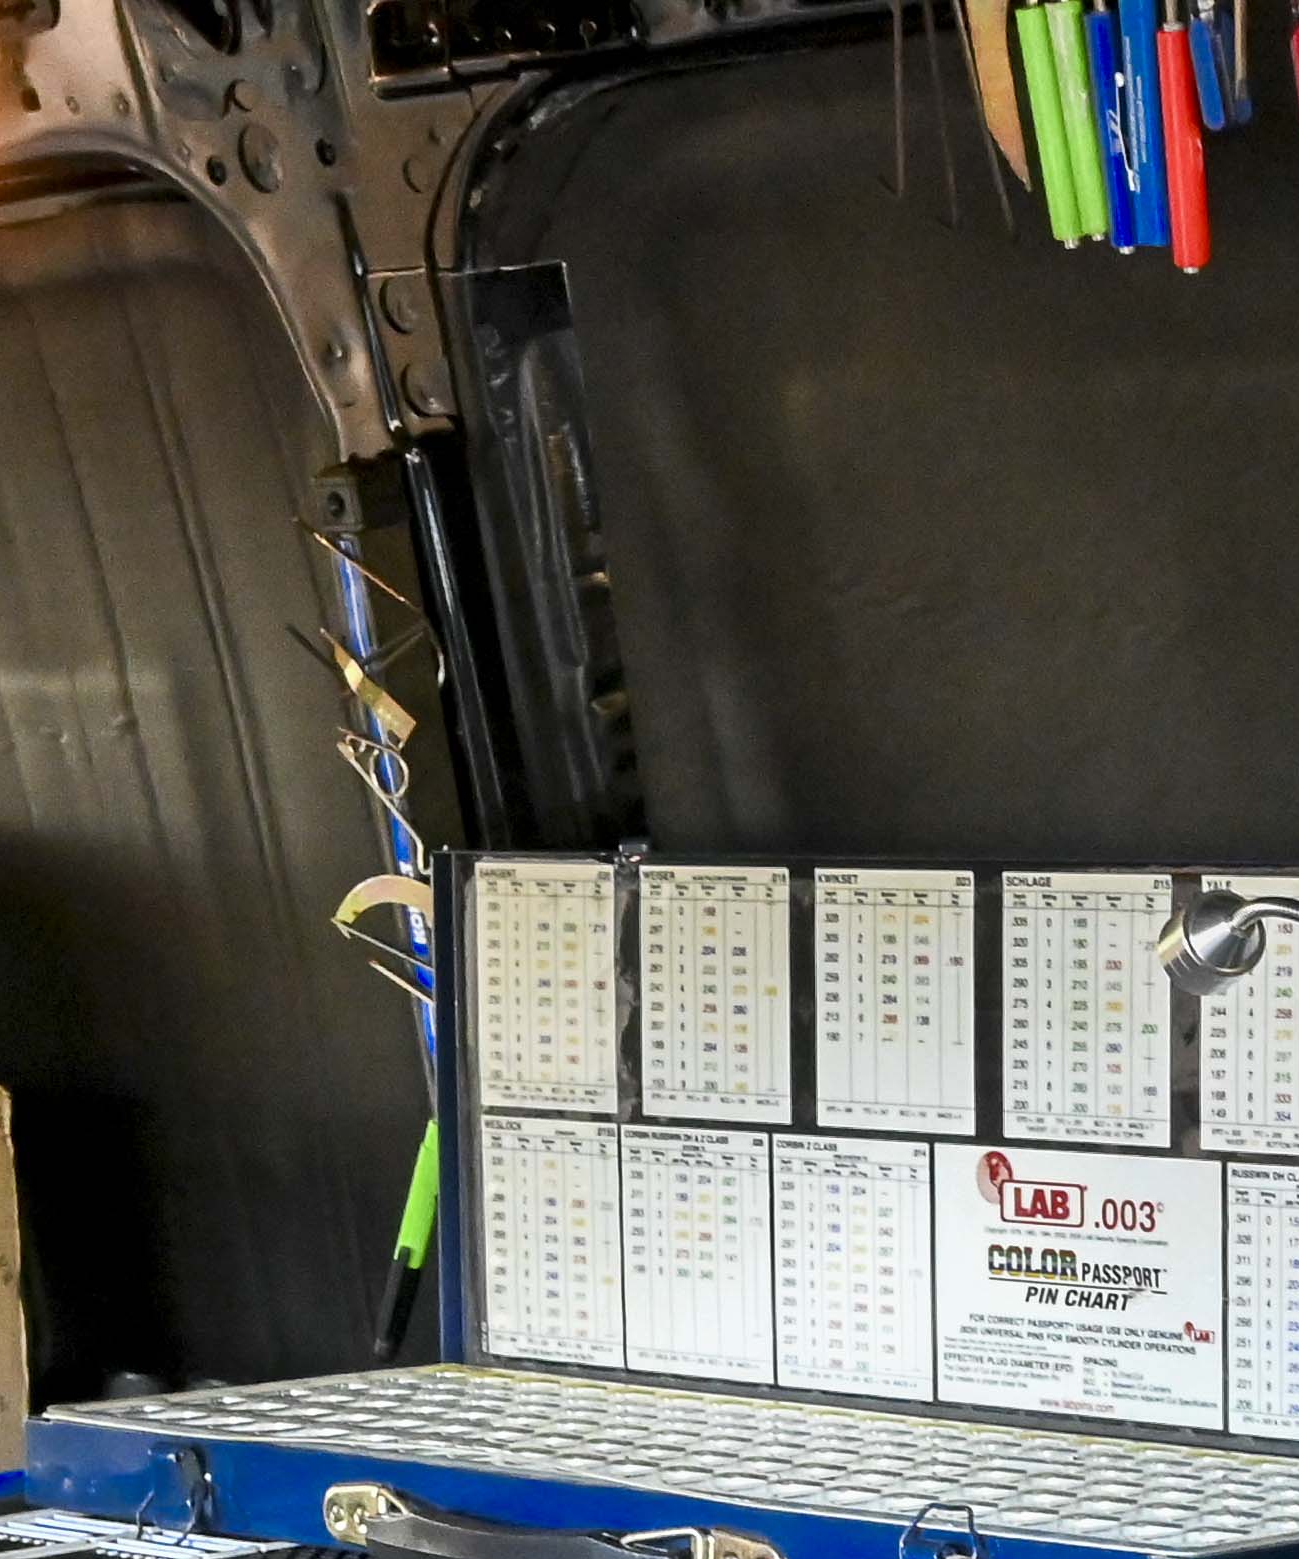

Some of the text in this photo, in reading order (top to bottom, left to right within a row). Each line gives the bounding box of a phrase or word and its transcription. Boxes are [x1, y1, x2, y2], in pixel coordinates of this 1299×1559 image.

[642, 872, 674, 881] WEISER
[818, 874, 858, 884] KWIKSET
[1006, 877, 1052, 887] SCHLAGE
[813, 1143, 837, 1152] CLASS
[1232, 1169, 1270, 1180] RUSSWIN
[1273, 1172, 1285, 1181] DH
[1014, 1186, 1070, 1220] LAB
[988, 1244, 1078, 1281] COLOR
[1025, 1286, 1134, 1311] PIN CHART
[969, 1314, 985, 1323] FOR
[987, 1315, 1025, 1328] CORRECT
[1075, 1322, 1103, 1334] USAGE
[1106, 1325, 1121, 1335] USE
[1124, 1326, 1145, 1338] ONLY
[1147, 1329, 1183, 1341] GENUINE
[1193, 1331, 1210, 1342] LAB
[980, 1327, 1024, 1340] UNIVERSAL
[1027, 1330, 1044, 1341] PINS
[1046, 1333, 1063, 1342] FOR
[1066, 1333, 1099, 1346] SMOOTH
[1101, 1337, 1141, 1350] CYLINDER
[1144, 1341, 1196, 1355] OPERATIONS
[943, 1352, 984, 1365] EFFECTIVE
[1010, 1357, 1050, 1371] DIAMETER
[1083, 1356, 1118, 1367] SPACING
